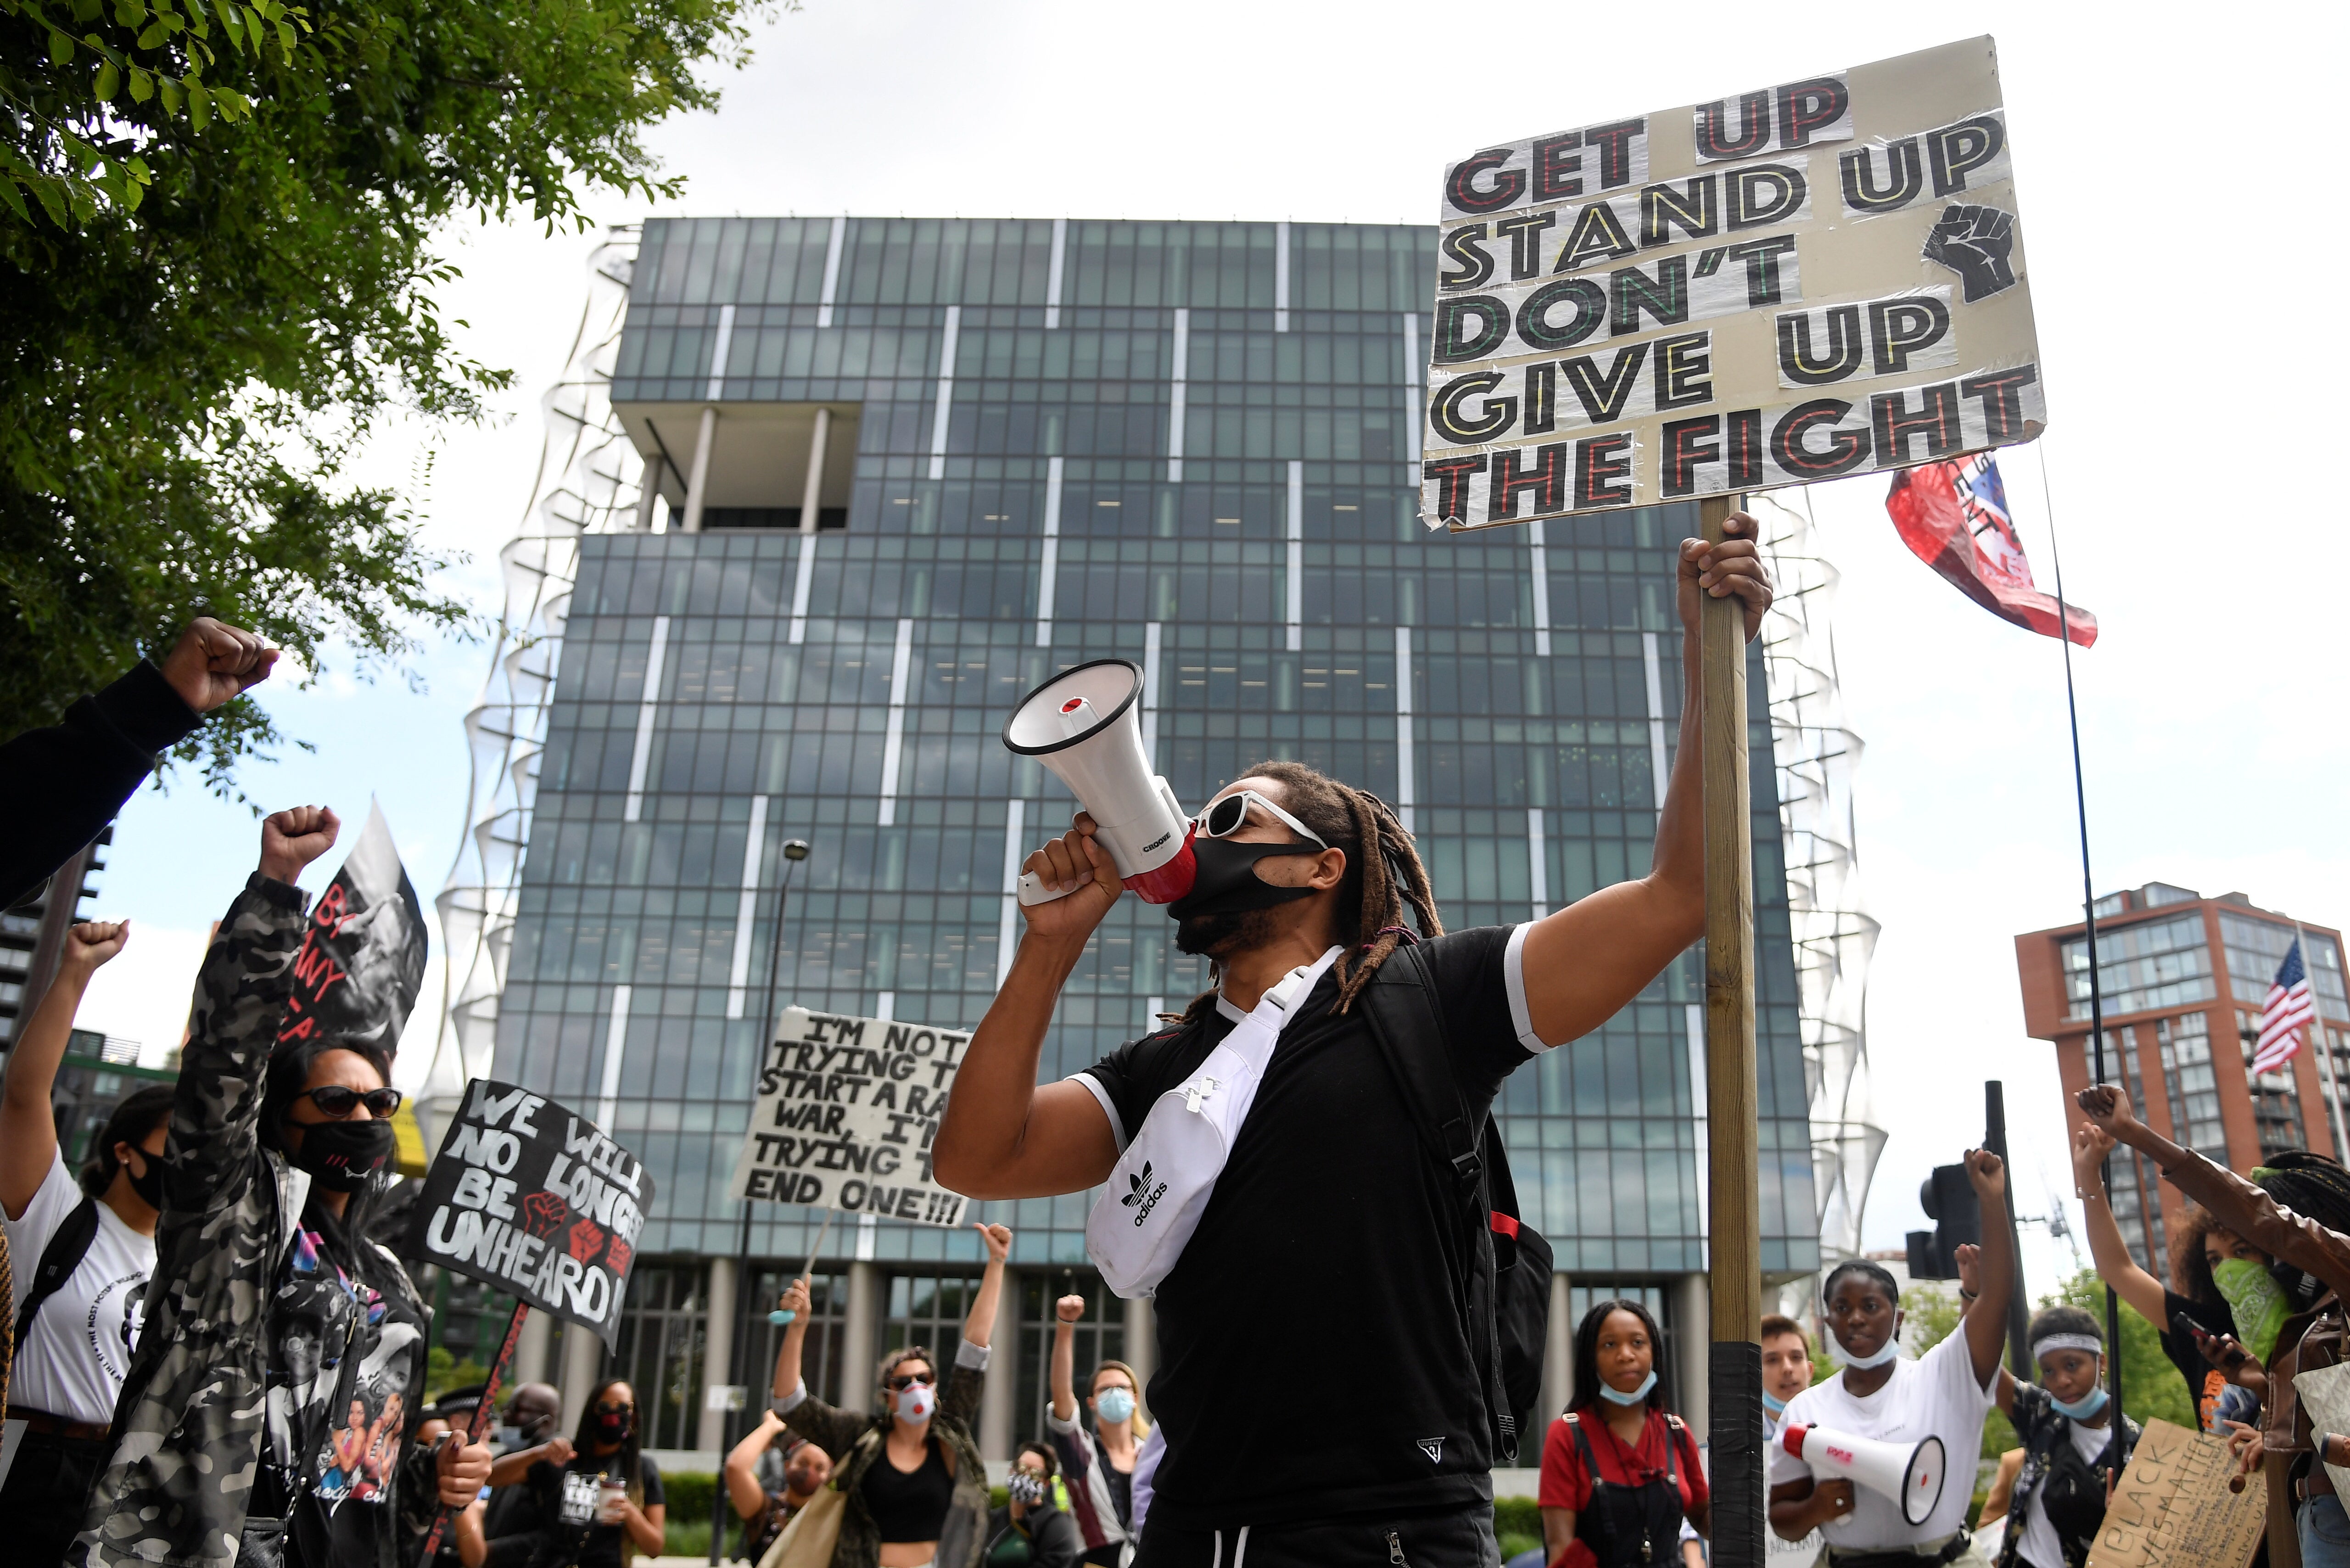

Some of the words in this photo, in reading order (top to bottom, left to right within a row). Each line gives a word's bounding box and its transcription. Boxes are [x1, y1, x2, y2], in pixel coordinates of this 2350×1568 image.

[1445, 118, 1644, 215] GET
[1695, 77, 1848, 161] UP
[1440, 163, 1807, 293] STAND
[1841, 116, 2004, 213] UP
[1434, 235, 1797, 364] DON'T
[1430, 330, 1714, 445] GIVE
[1775, 295, 1949, 384] UP
[1425, 431, 1633, 526] THE
[1662, 364, 2035, 494] FIGHT
[1946, 460, 2000, 537] CENT
[774, 1040, 917, 1080] TRYING
[931, 1059, 960, 1089] T
[804, 1016, 865, 1045] I'M
[884, 1025, 966, 1061] NOT
[759, 1067, 871, 1103] START
[872, 1082, 895, 1109] A
[906, 1085, 947, 1116] RA
[444, 1123, 521, 1175] NO
[467, 1081, 547, 1139] WE
[565, 1117, 643, 1199] WILL
[775, 1101, 852, 1144] WAR,
[755, 1132, 899, 1174] TRYING
[452, 1167, 519, 1221] BE
[745, 1168, 822, 1204] END
[840, 1180, 962, 1224] ONE!!!
[1134, 1182, 1168, 1227] adidas
[116, 1271, 145, 1284] WEAPO
[88, 1305, 98, 1327] MOST
[89, 1331, 98, 1346] THE
[2104, 1445, 2177, 1552] BLACK
